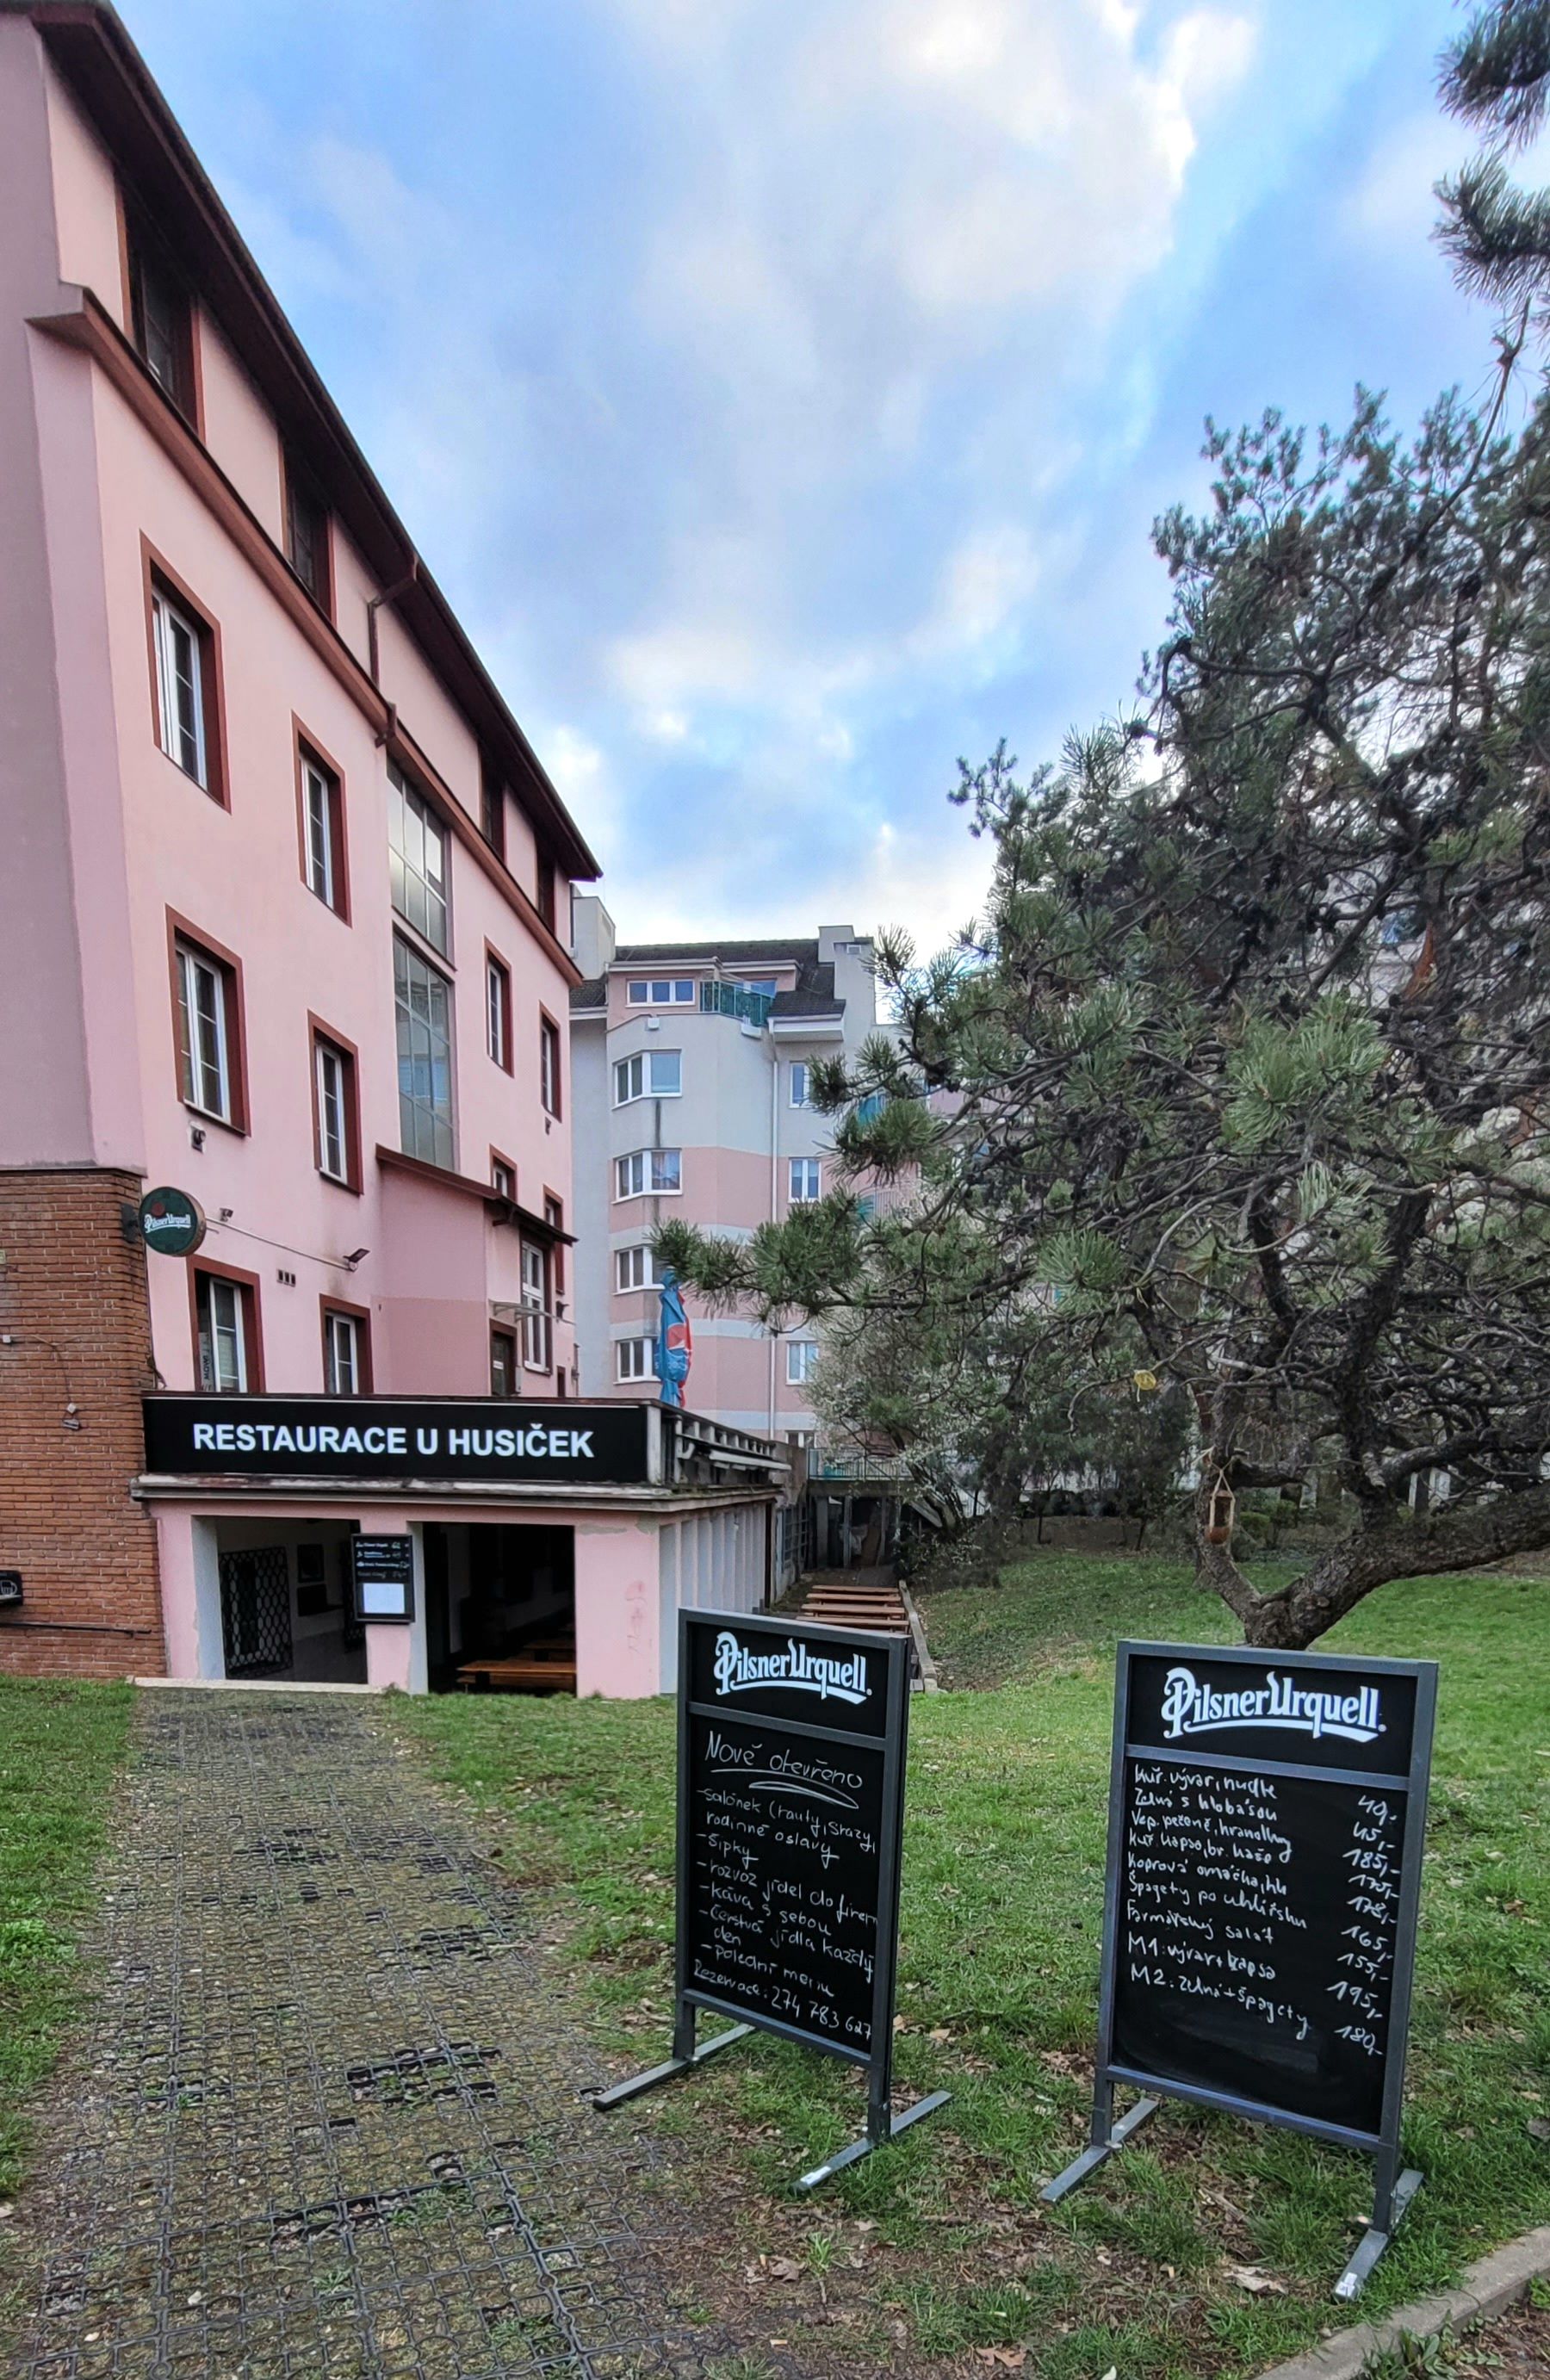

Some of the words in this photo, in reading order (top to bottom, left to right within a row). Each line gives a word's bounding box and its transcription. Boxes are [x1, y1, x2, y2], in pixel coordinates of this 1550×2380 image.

[192, 1422, 408, 1454] RESTAURACE
[416, 1428, 438, 1455] U
[448, 1422, 595, 1458] HUSIČEK
[713, 1631, 790, 1696] Pilsner
[787, 1637, 866, 1701] Urquell
[1161, 1666, 1269, 1739] Pilsner
[1266, 1670, 1380, 1739] Urquell
[761, 1904, 772, 1917] s
[809, 1889, 834, 1907] do
[1198, 1889, 1217, 1906] po
[714, 1924, 741, 1946] den
[771, 1985, 800, 2018] 274
